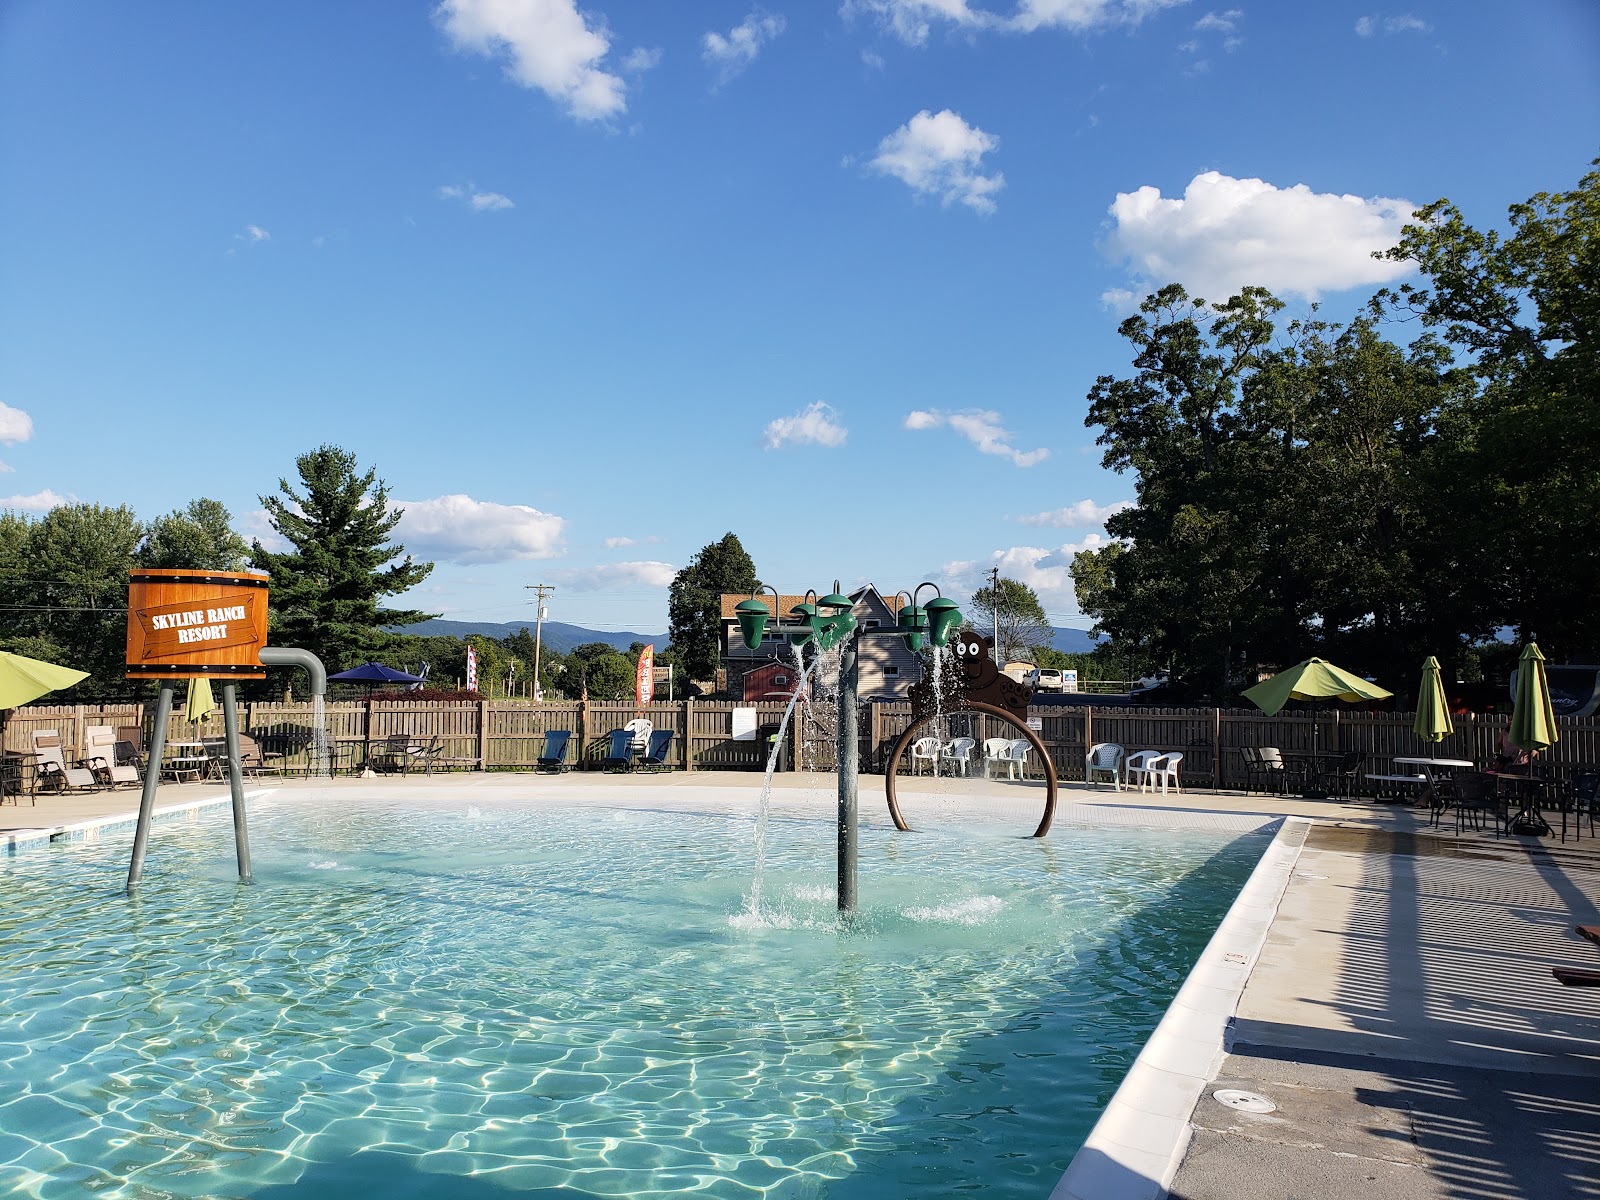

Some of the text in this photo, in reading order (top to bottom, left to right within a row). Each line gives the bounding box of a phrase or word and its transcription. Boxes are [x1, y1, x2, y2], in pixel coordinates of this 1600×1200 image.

[152, 605, 246, 630] SKYLINE RANCH
[178, 624, 228, 644] RESORT
[1550, 697, 1578, 707] untry
